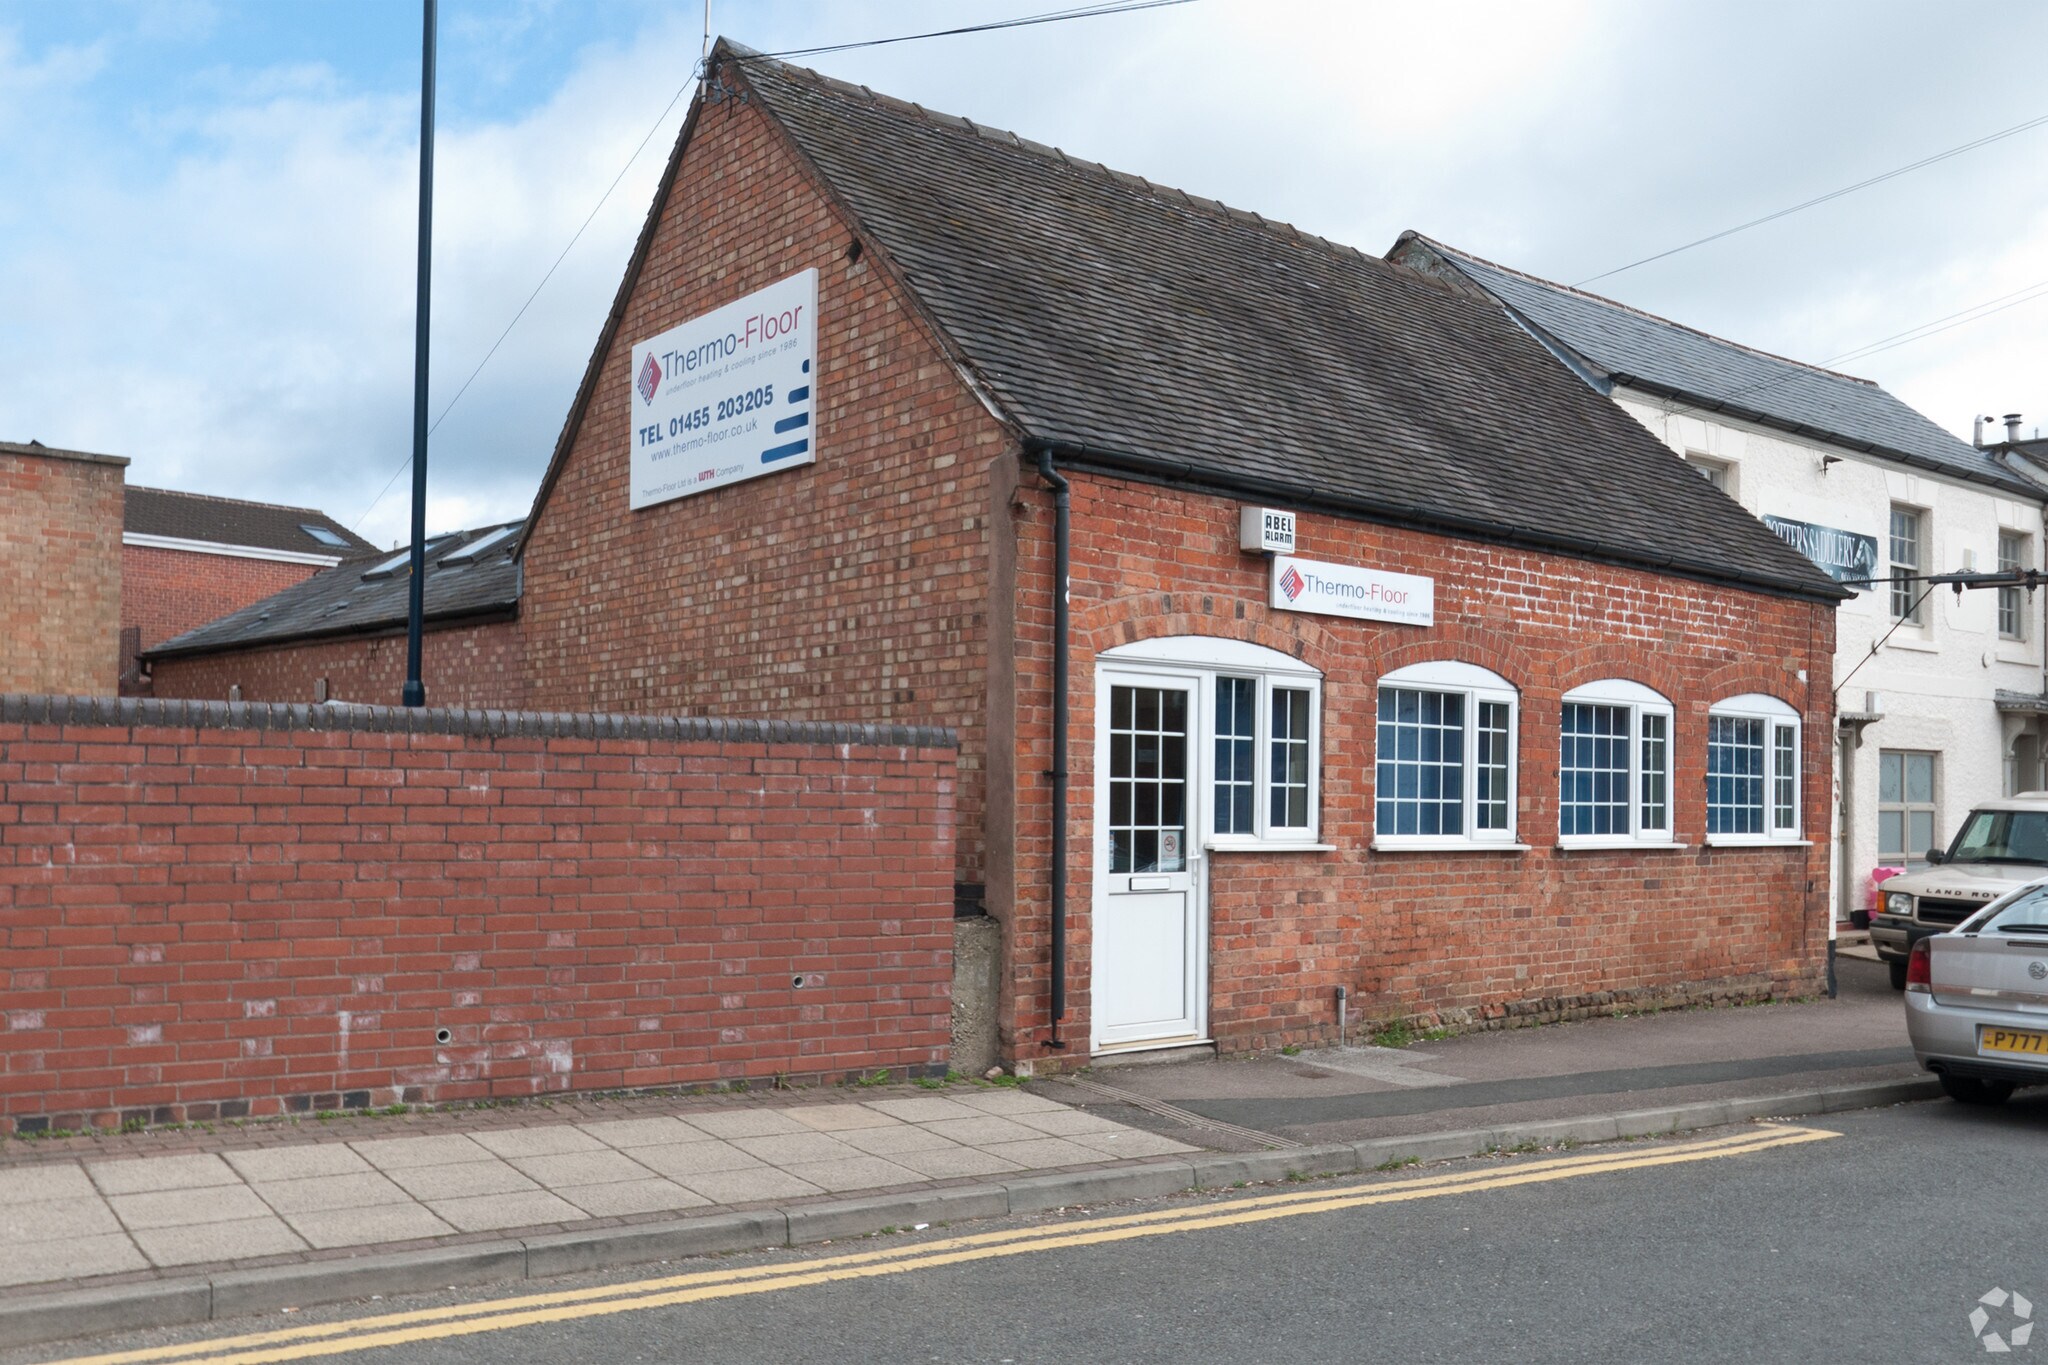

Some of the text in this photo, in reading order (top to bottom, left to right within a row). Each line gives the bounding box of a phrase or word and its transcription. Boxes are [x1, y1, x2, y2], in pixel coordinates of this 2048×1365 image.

[662, 305, 803, 380] Thermo-Floor
[665, 337, 797, 396] underfloor heating & cooling since 1986
[639, 384, 773, 447] TEL 01455 203205
[651, 417, 758, 462] www.thermo-floor.co.uk
[642, 483, 676, 497] Thermo-Floor
[687, 478, 692, 486] is
[716, 463, 744, 478] Company
[1265, 515, 1292, 532] ABEL
[1265, 530, 1292, 544] ALARM
[1765, 519, 1855, 569] TTERS SADDLERY
[1304, 574, 1408, 604] Thermo-Floor
[1926, 888, 2000, 899] LAND ROV
[1994, 1031, 2042, 1051] P777
